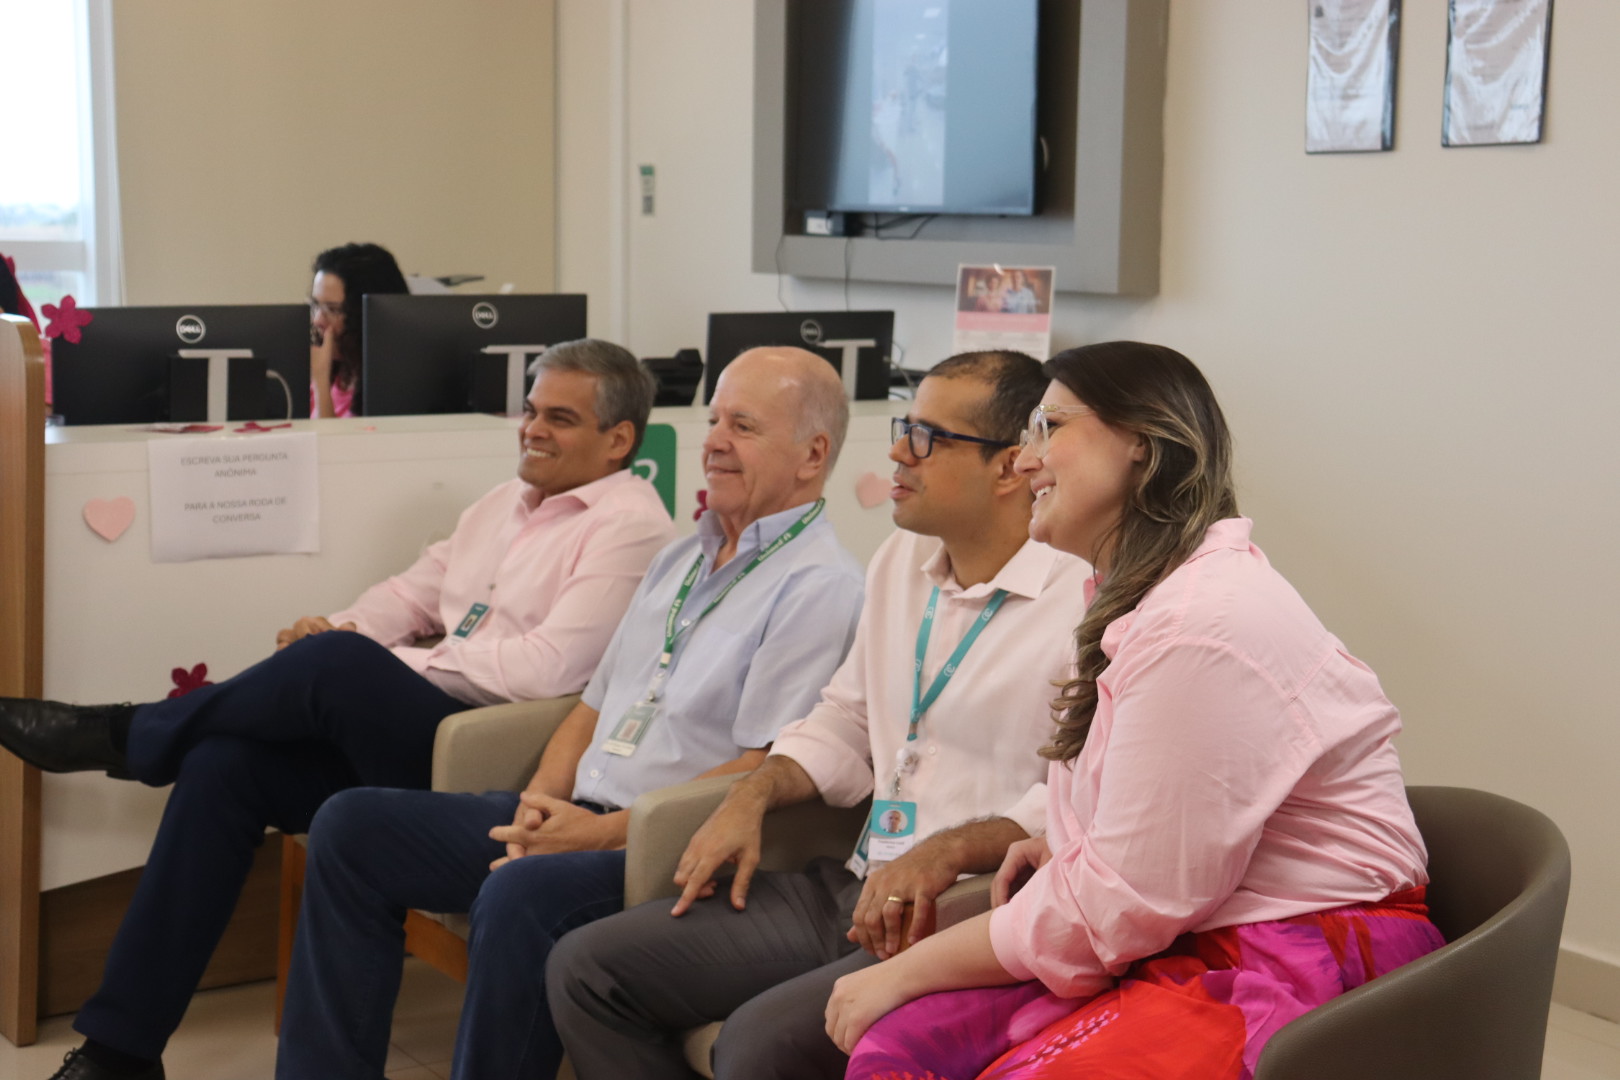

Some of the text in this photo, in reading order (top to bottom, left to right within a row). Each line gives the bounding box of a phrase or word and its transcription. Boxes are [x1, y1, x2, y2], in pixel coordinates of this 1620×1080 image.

[180, 452, 288, 466] ESCREVA SUA PERGUNTA
[184, 496, 287, 512] PARA A NOSSA RODA DE
[212, 513, 261, 524] CONVERSA
